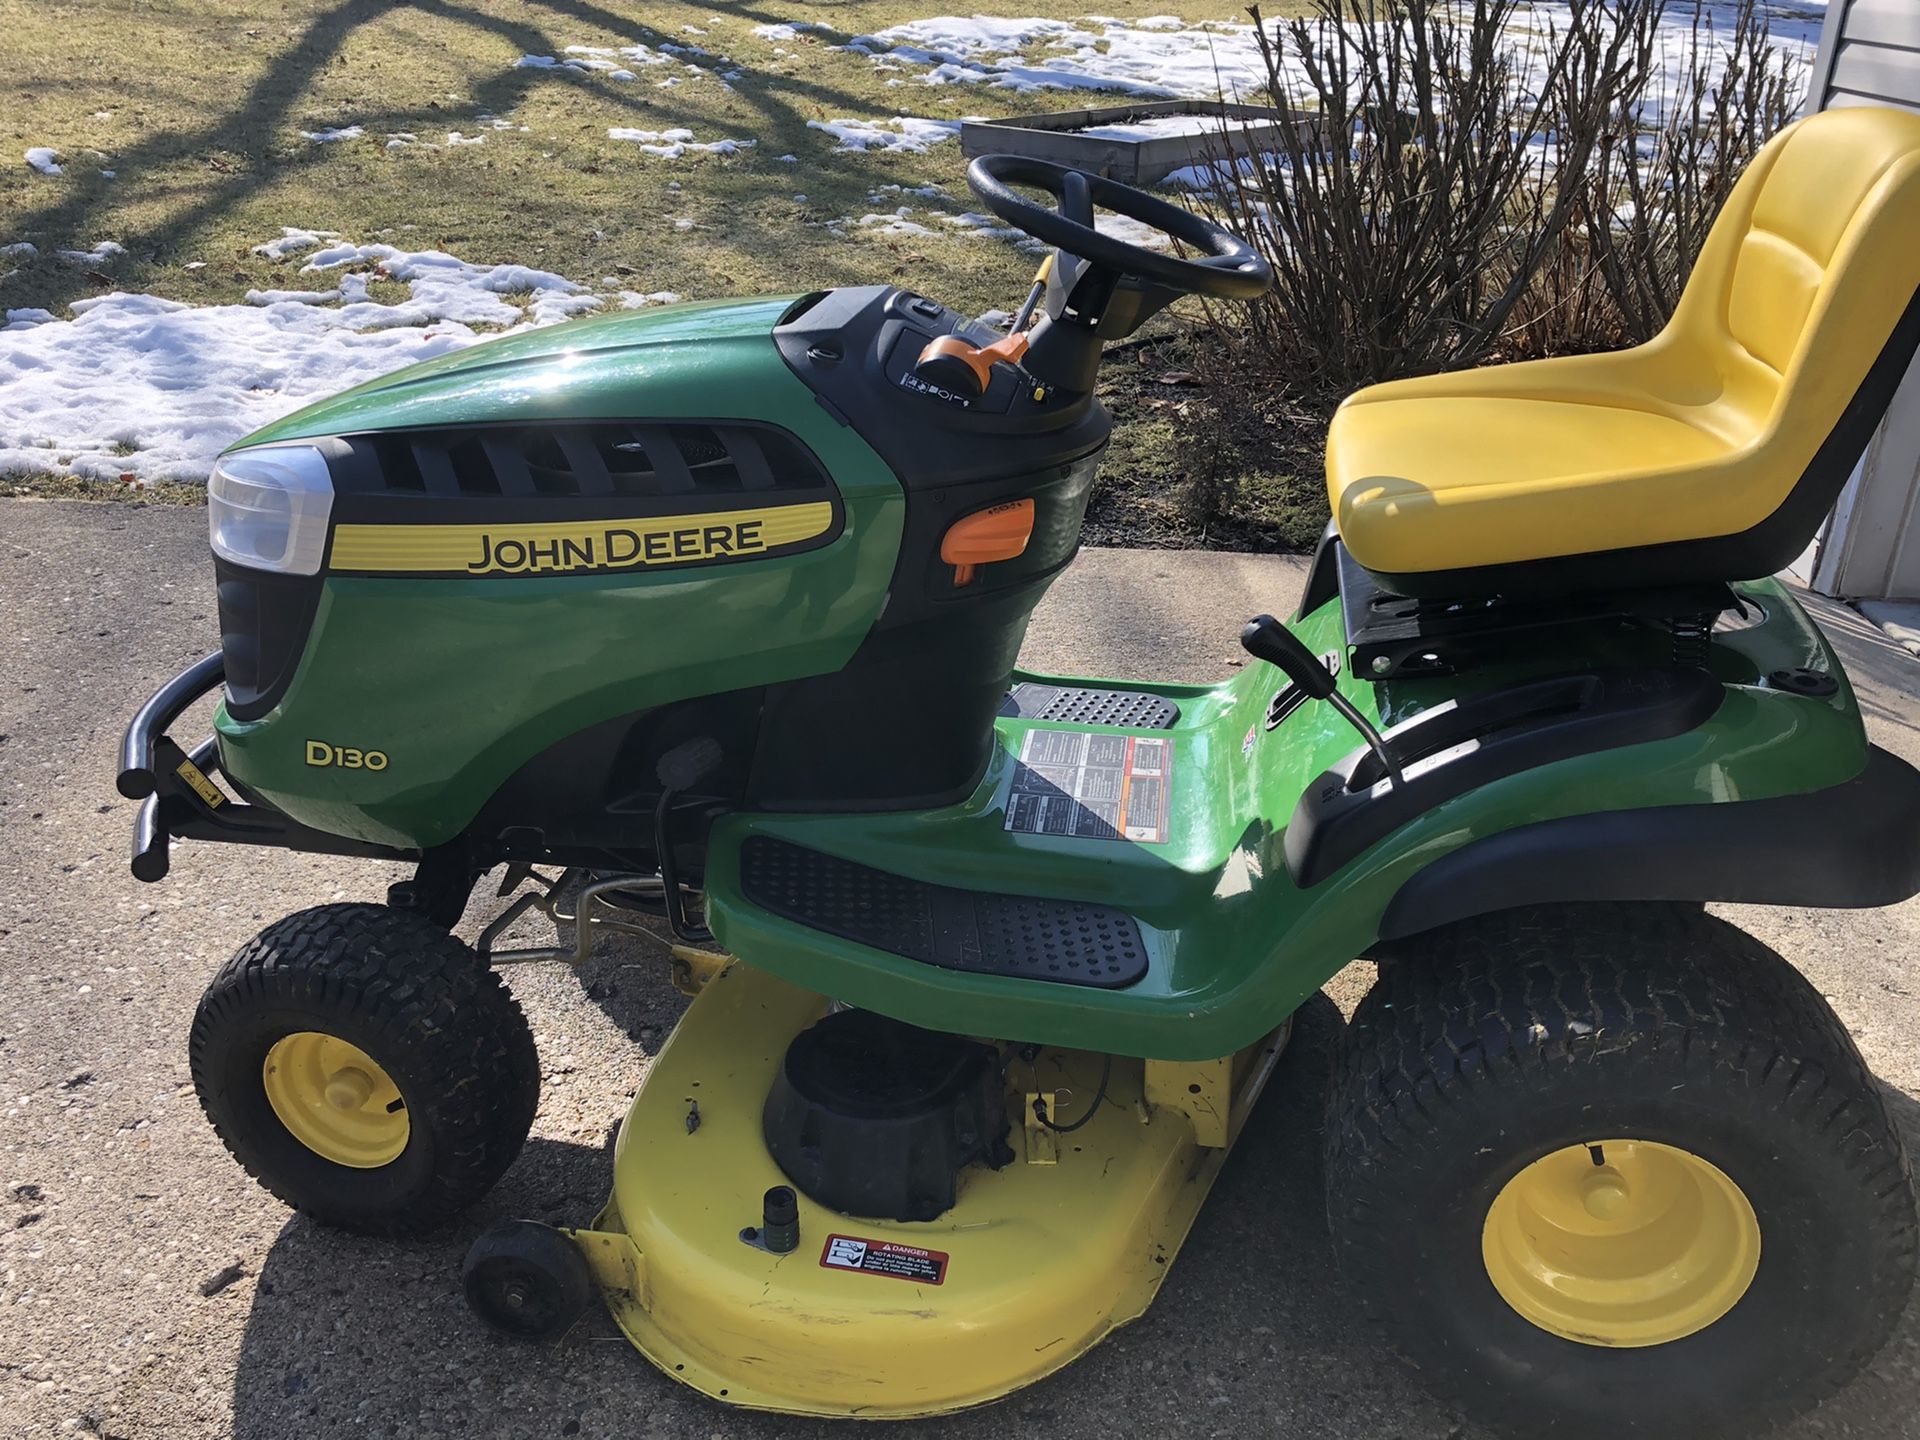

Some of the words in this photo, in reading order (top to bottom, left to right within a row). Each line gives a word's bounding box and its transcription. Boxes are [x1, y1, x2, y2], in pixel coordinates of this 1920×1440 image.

[468, 535, 595, 568] JOHN
[604, 521, 763, 563] DEERE
[306, 740, 388, 770] D130
[892, 1245, 929, 1256] DANGER
[873, 1251, 906, 1260] ROTATING
[907, 1256, 930, 1264] BLADE
[890, 1268, 912, 1276] running
